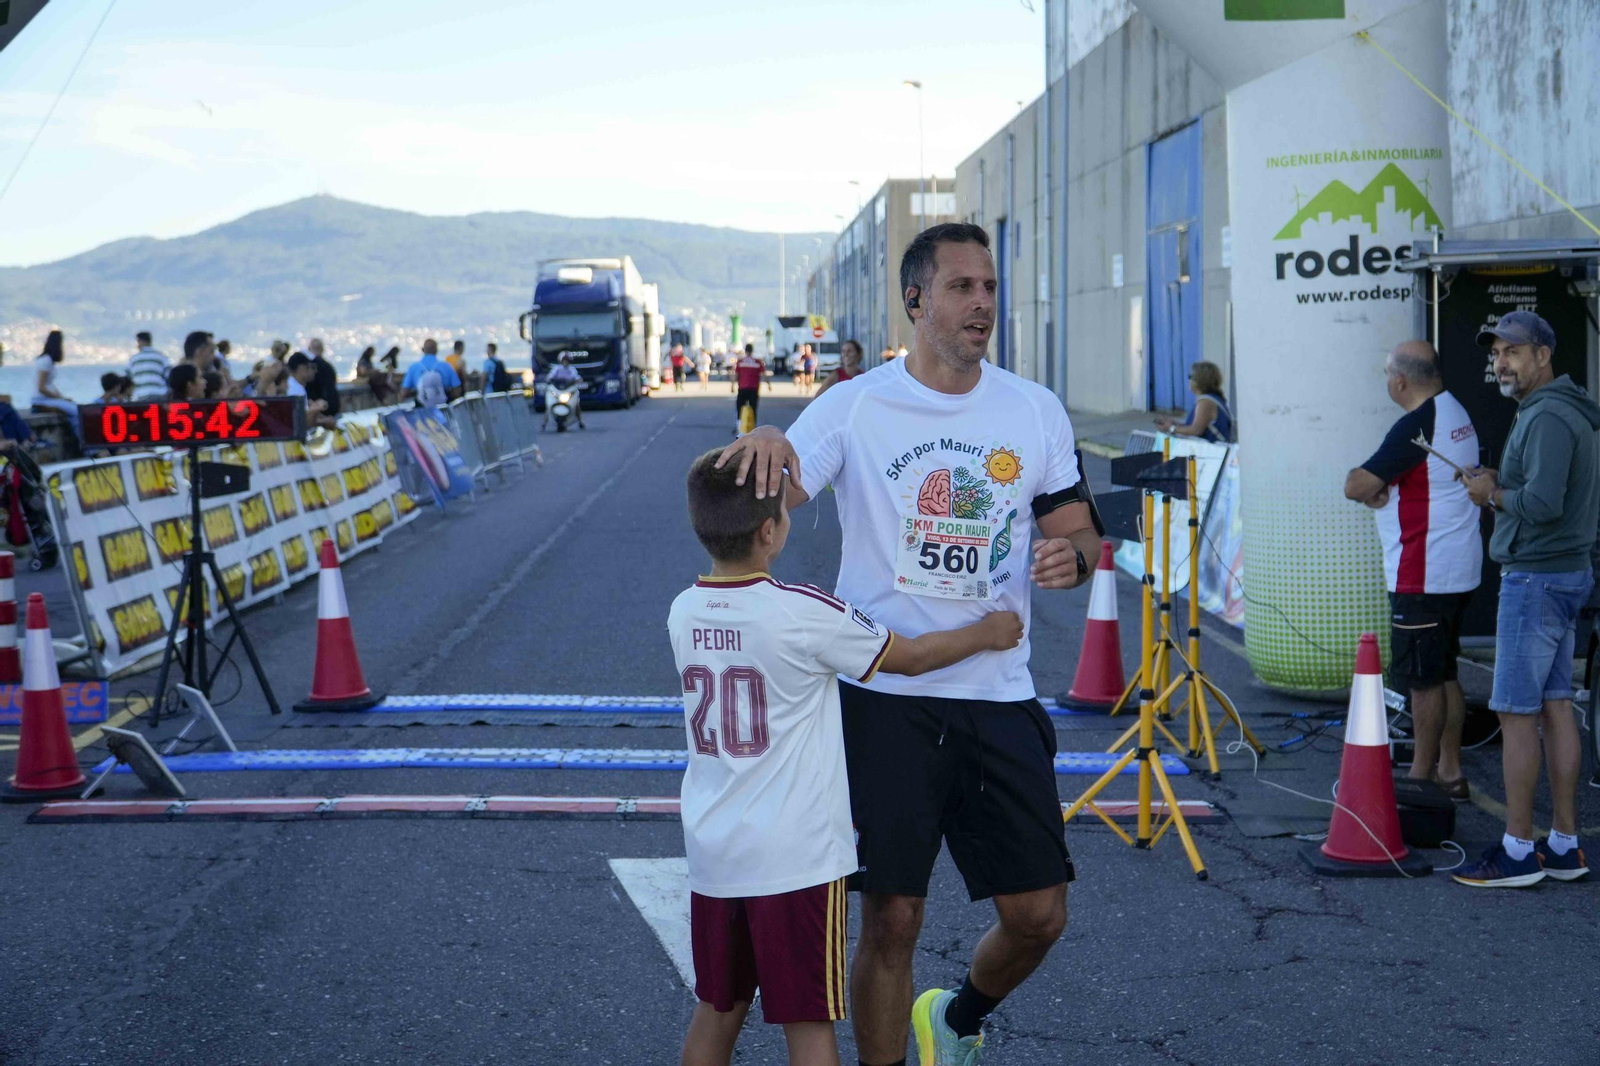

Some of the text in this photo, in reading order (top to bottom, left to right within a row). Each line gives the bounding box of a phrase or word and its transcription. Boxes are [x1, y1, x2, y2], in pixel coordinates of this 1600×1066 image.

[1266, 148, 1443, 168] INGENIERÍA&INMOBILIARIA
[1275, 234, 1413, 280] rodes
[1296, 285, 1413, 304] www.rodesp
[1488, 284, 1537, 293] Atletismo
[1493, 294, 1537, 303] Ciclismo
[102, 400, 260, 443] 0:15:42
[886, 438, 984, 481] 5Km por Mauri
[906, 518, 991, 537] 5KM POR MAURI
[918, 541, 978, 574] 560
[928, 571, 955, 579] FRANCISCO
[692, 628, 741, 651] PEDRI
[681, 665, 770, 758] 20
